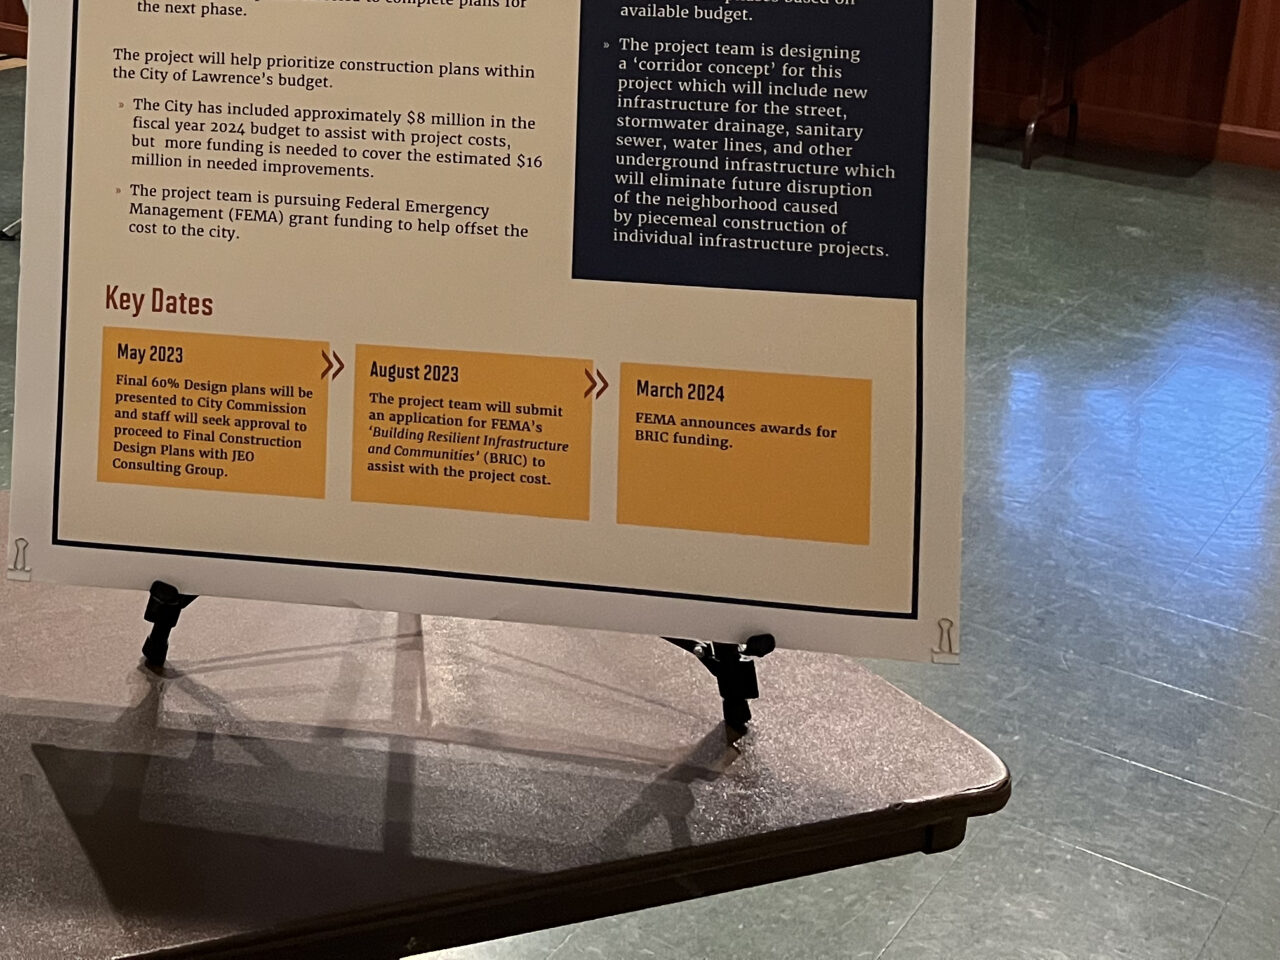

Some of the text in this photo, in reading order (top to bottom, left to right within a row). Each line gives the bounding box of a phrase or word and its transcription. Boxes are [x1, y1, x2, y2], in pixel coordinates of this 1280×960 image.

[112, 47, 534, 78] The project will help prioritize construction plans within
[112, 65, 333, 91] the City of Lawrence’s budget.
[105, 284, 213, 318] Key Dates
[117, 342, 183, 365] May 2023
[369, 360, 458, 382] August 2023
[116, 373, 313, 399] Final 60% Design plans will be
[636, 379, 724, 402] March 2024
[114, 393, 306, 415] presented to City Commission
[368, 392, 563, 417] The project team will submit
[114, 408, 307, 432] and staff will seek approval to
[368, 411, 542, 433] an application for FEMA’s
[635, 412, 837, 438] FEMA announces awards for
[114, 426, 301, 448] proceed to Final Construction
[368, 425, 569, 452] ‘Building Resilient Infrastructure
[635, 429, 732, 451] BRIC funding.
[113, 441, 254, 462] Design Plans with JEO
[367, 443, 545, 468] and Communities’ (BRIC) to
[112, 457, 227, 479] Consulting Group.
[367, 460, 551, 485] assist with the project cost.
